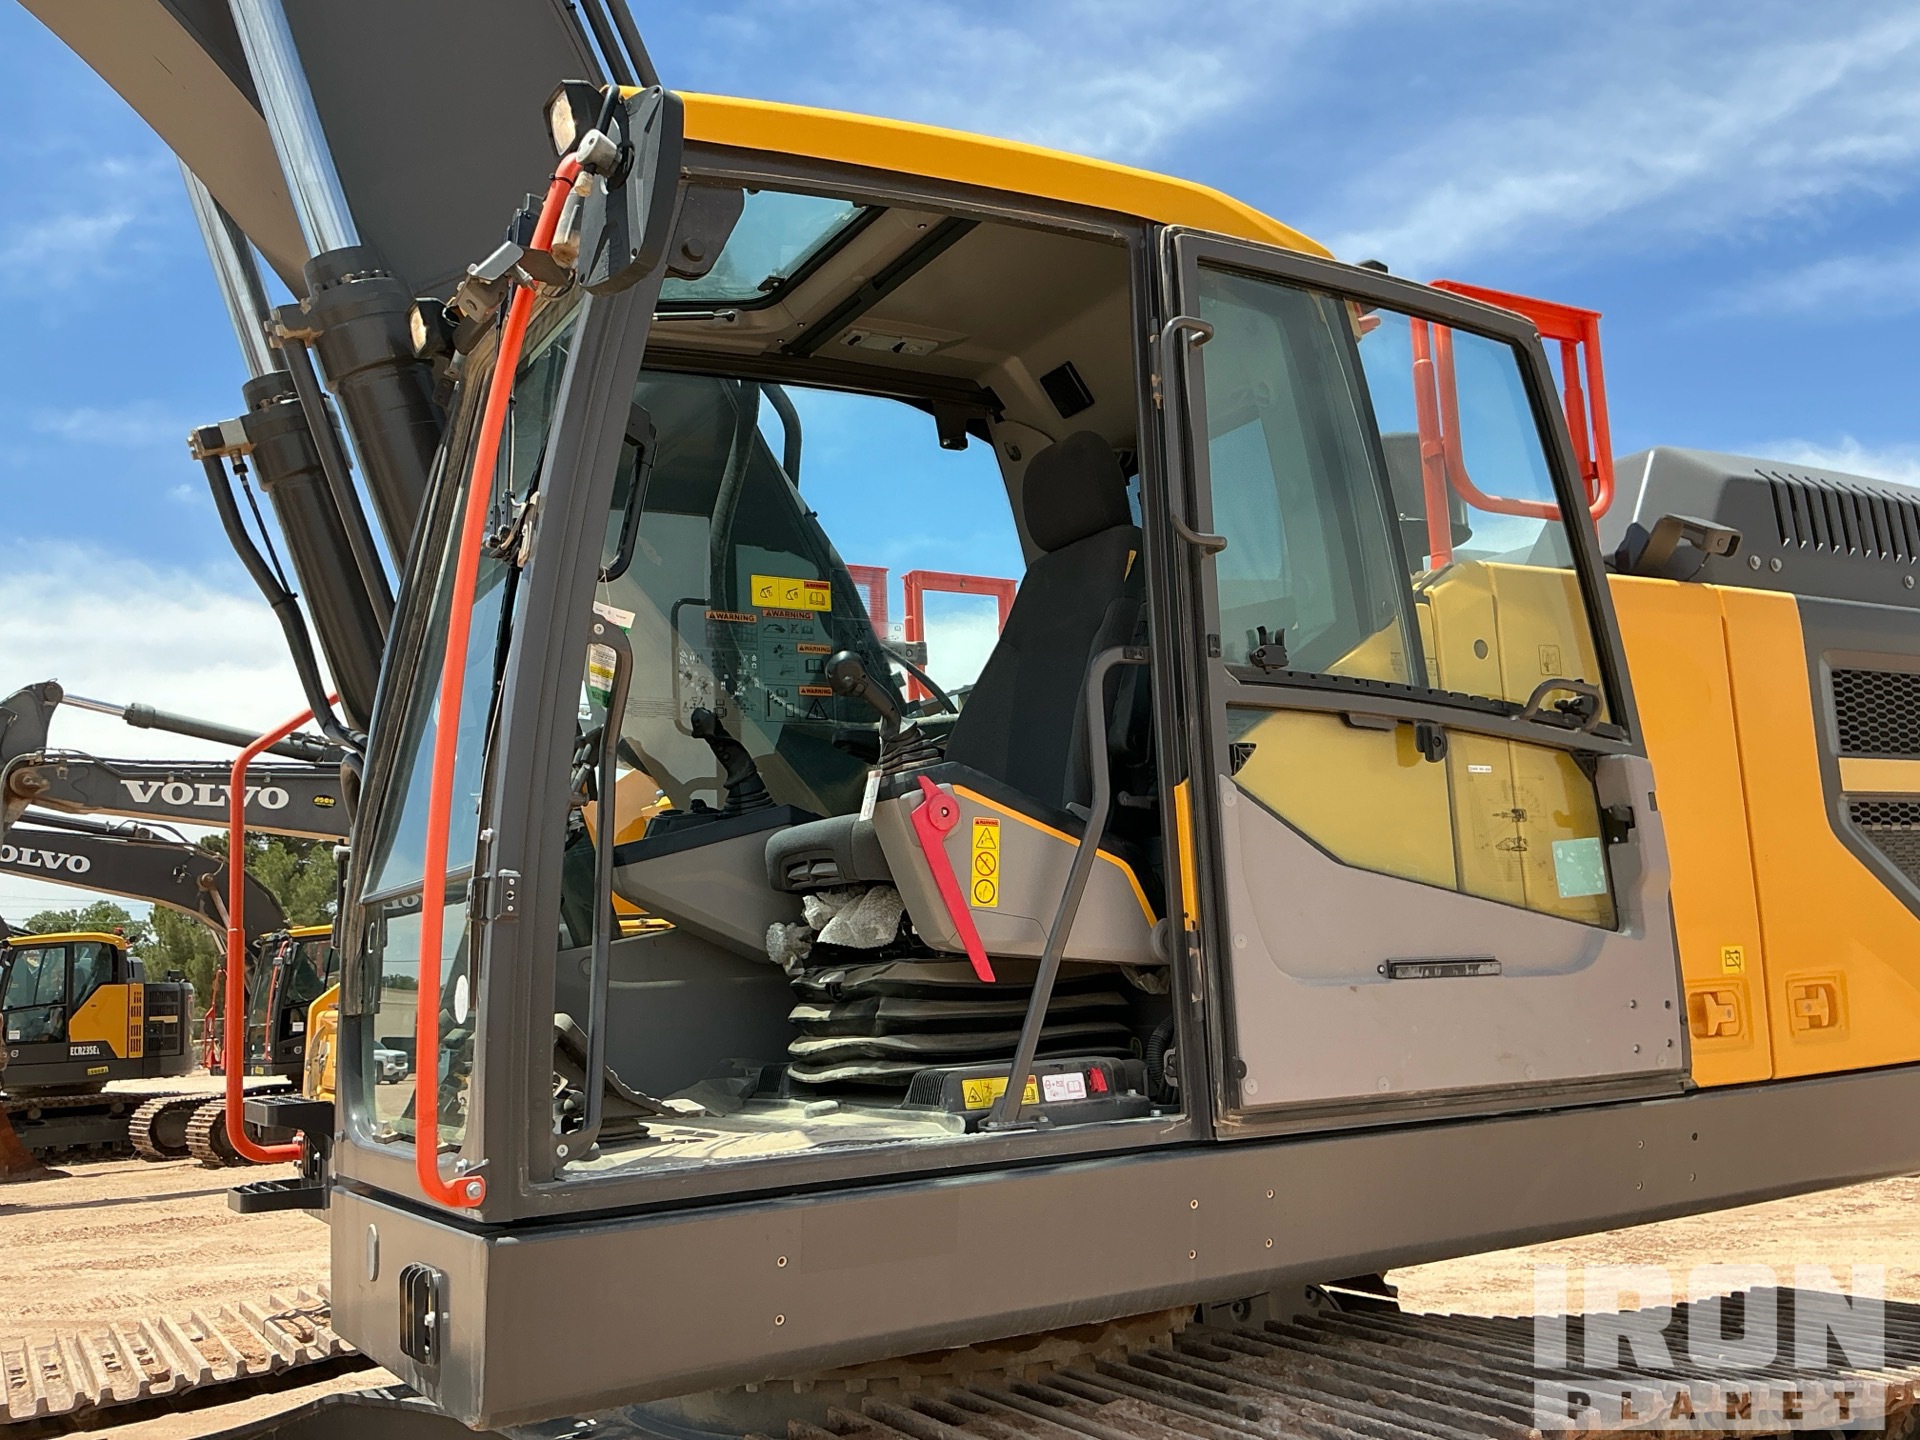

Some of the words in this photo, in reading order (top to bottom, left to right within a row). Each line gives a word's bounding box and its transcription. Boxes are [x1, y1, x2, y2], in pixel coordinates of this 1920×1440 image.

[717, 613, 755, 622] WARNING
[771, 610, 811, 619] WARNING
[120, 780, 290, 810] VOLVO
